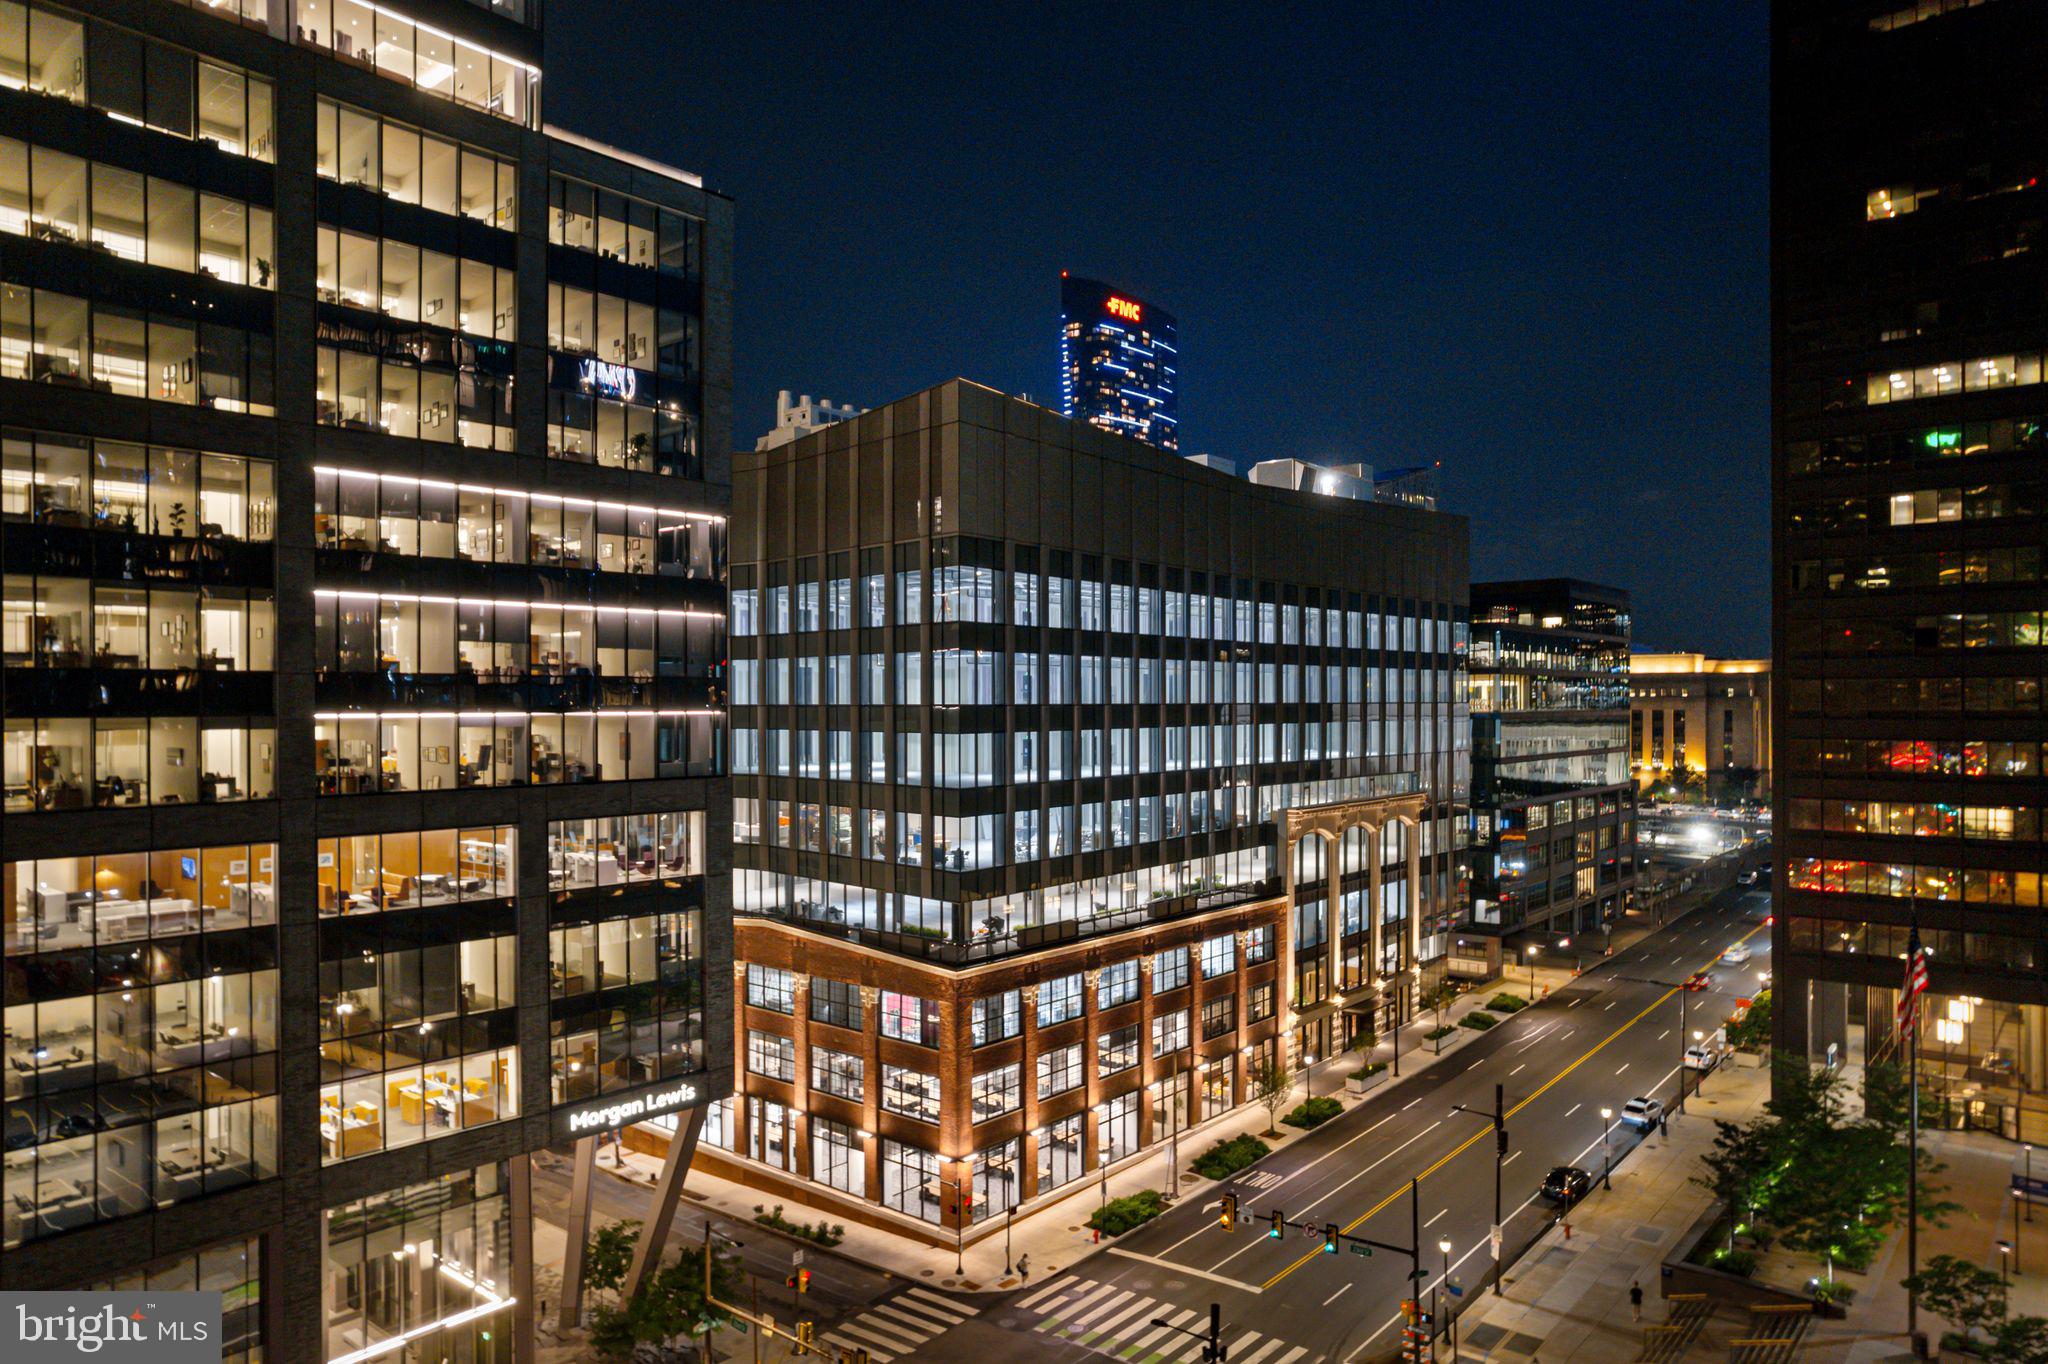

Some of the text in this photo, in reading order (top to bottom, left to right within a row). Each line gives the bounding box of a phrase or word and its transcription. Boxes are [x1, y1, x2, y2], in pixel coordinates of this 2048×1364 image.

[1107, 296, 1140, 321] FMC
[569, 1083, 697, 1132] Morgan Lewis
[1233, 1170, 1283, 1189] ONLY
